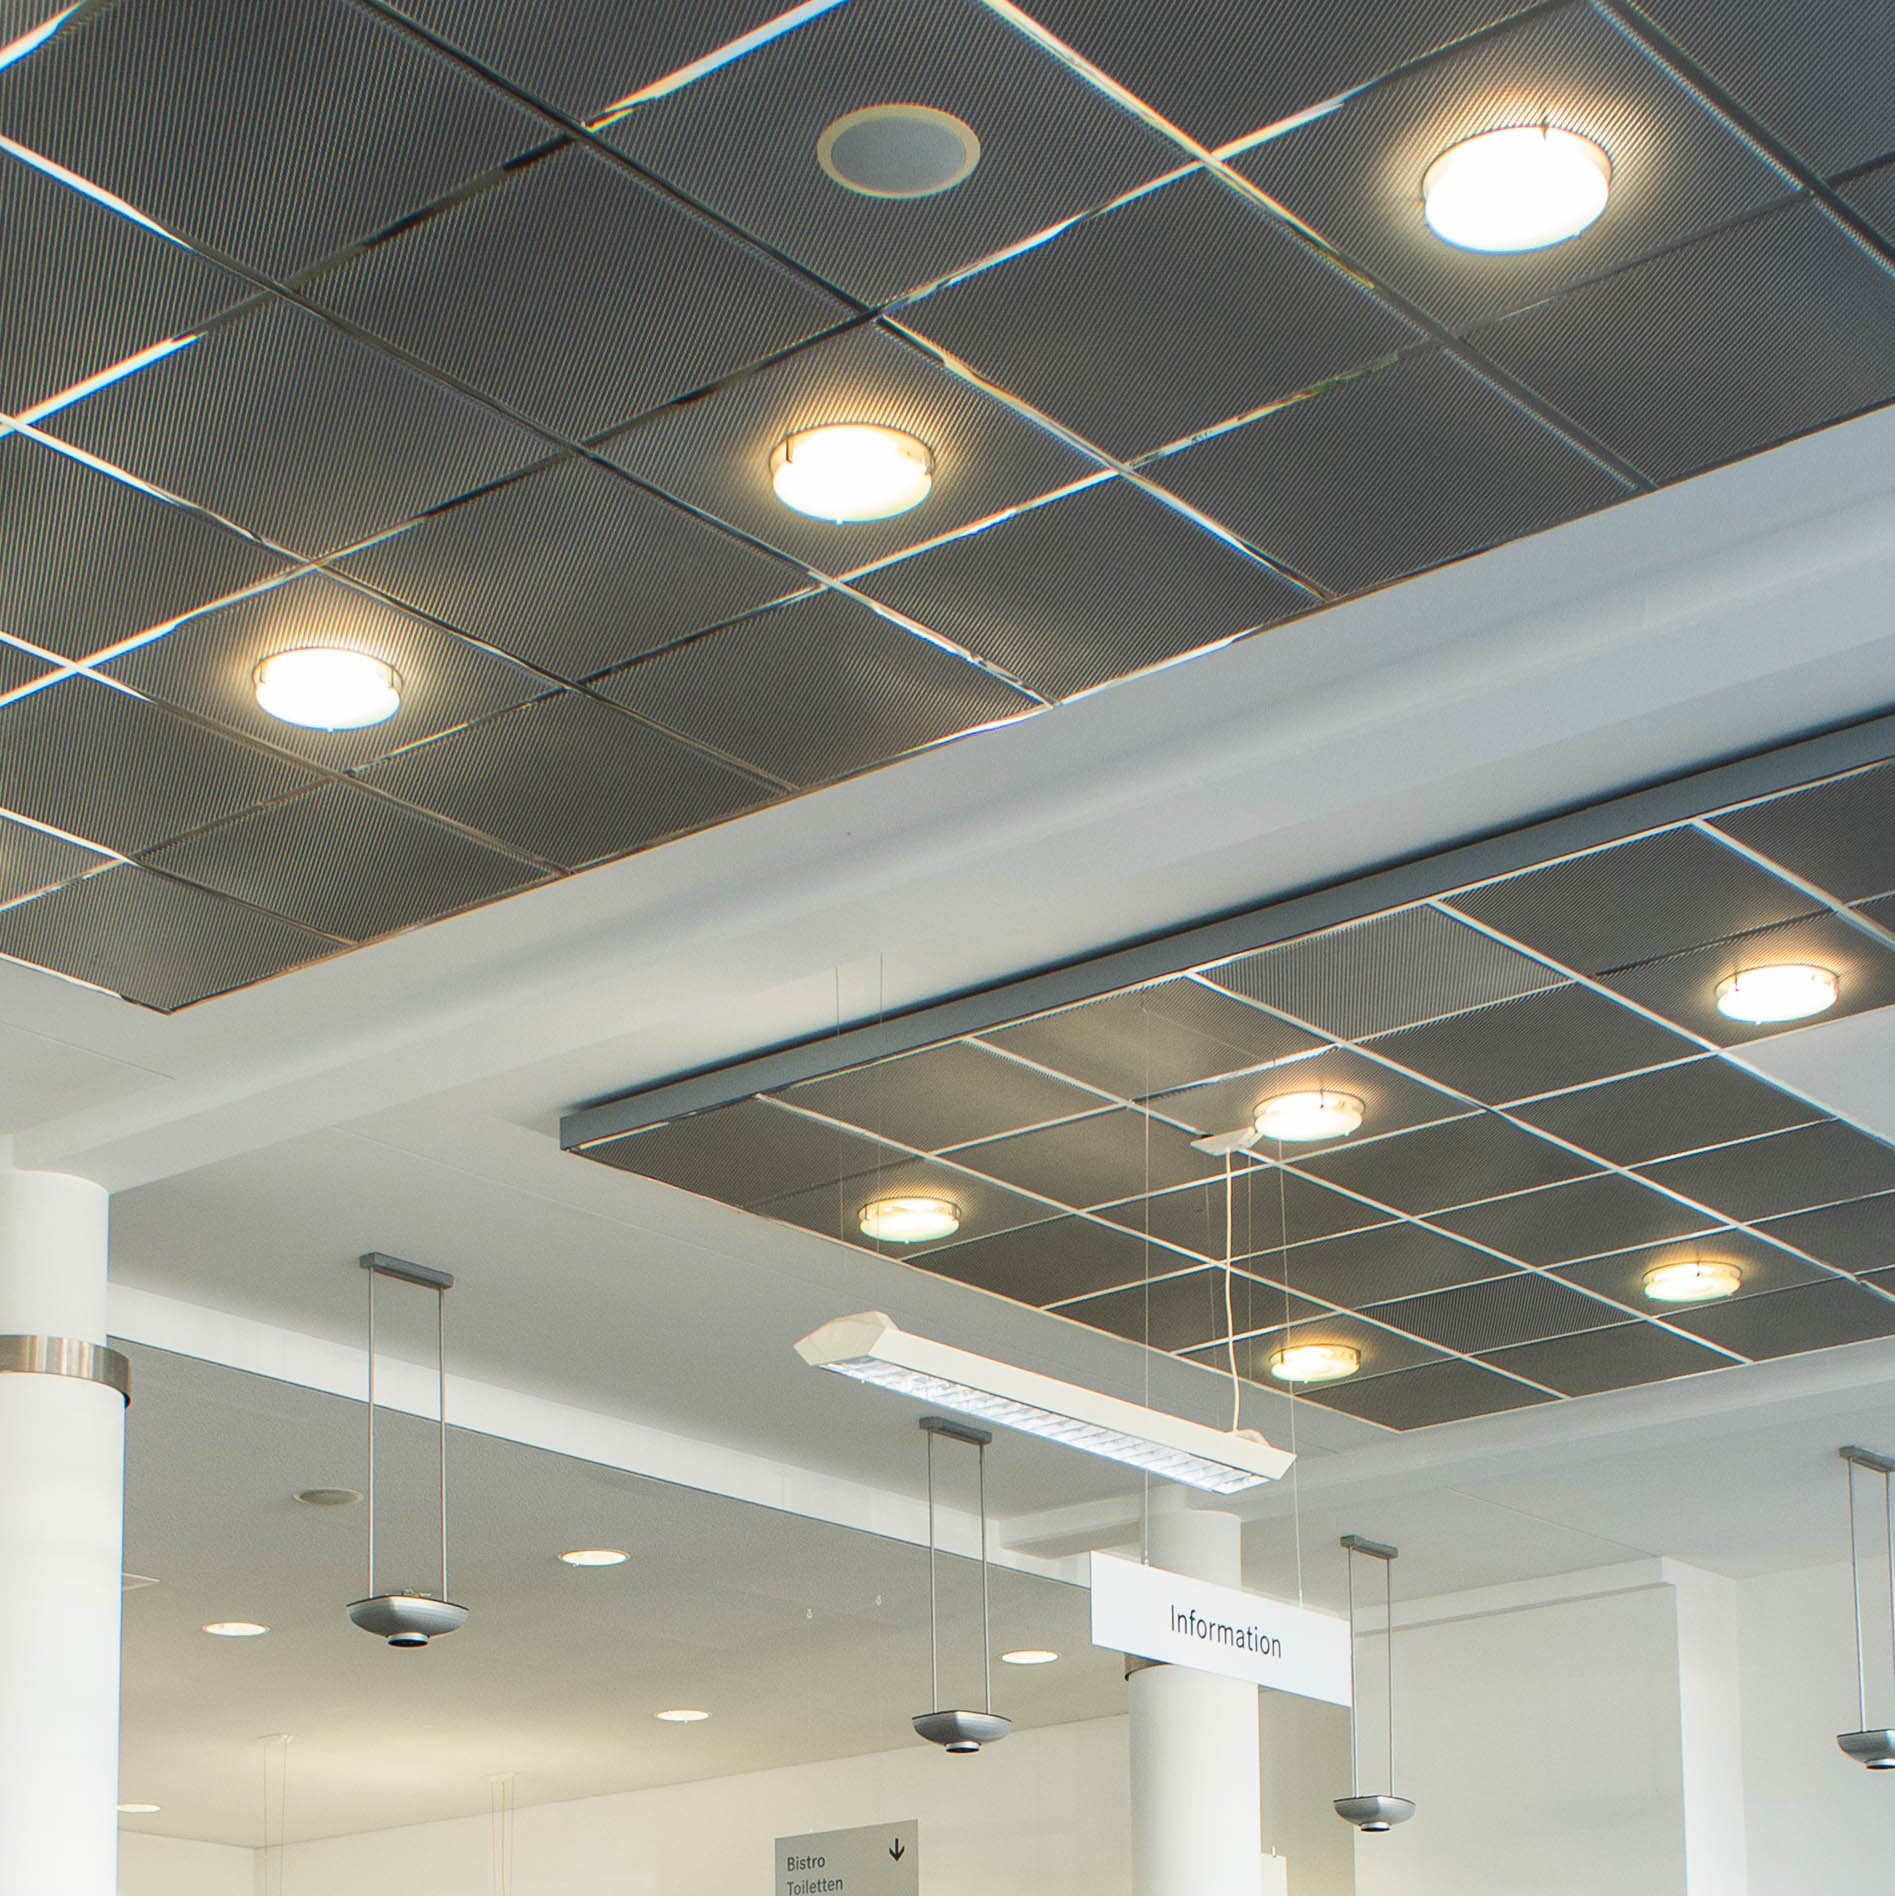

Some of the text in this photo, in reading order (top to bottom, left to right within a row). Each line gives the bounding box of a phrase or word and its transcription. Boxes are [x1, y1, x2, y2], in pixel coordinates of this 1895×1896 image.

[1170, 1604, 1282, 1659] Information
[787, 1855, 826, 1872] Bistro
[787, 1878, 844, 1896] Toiletten
